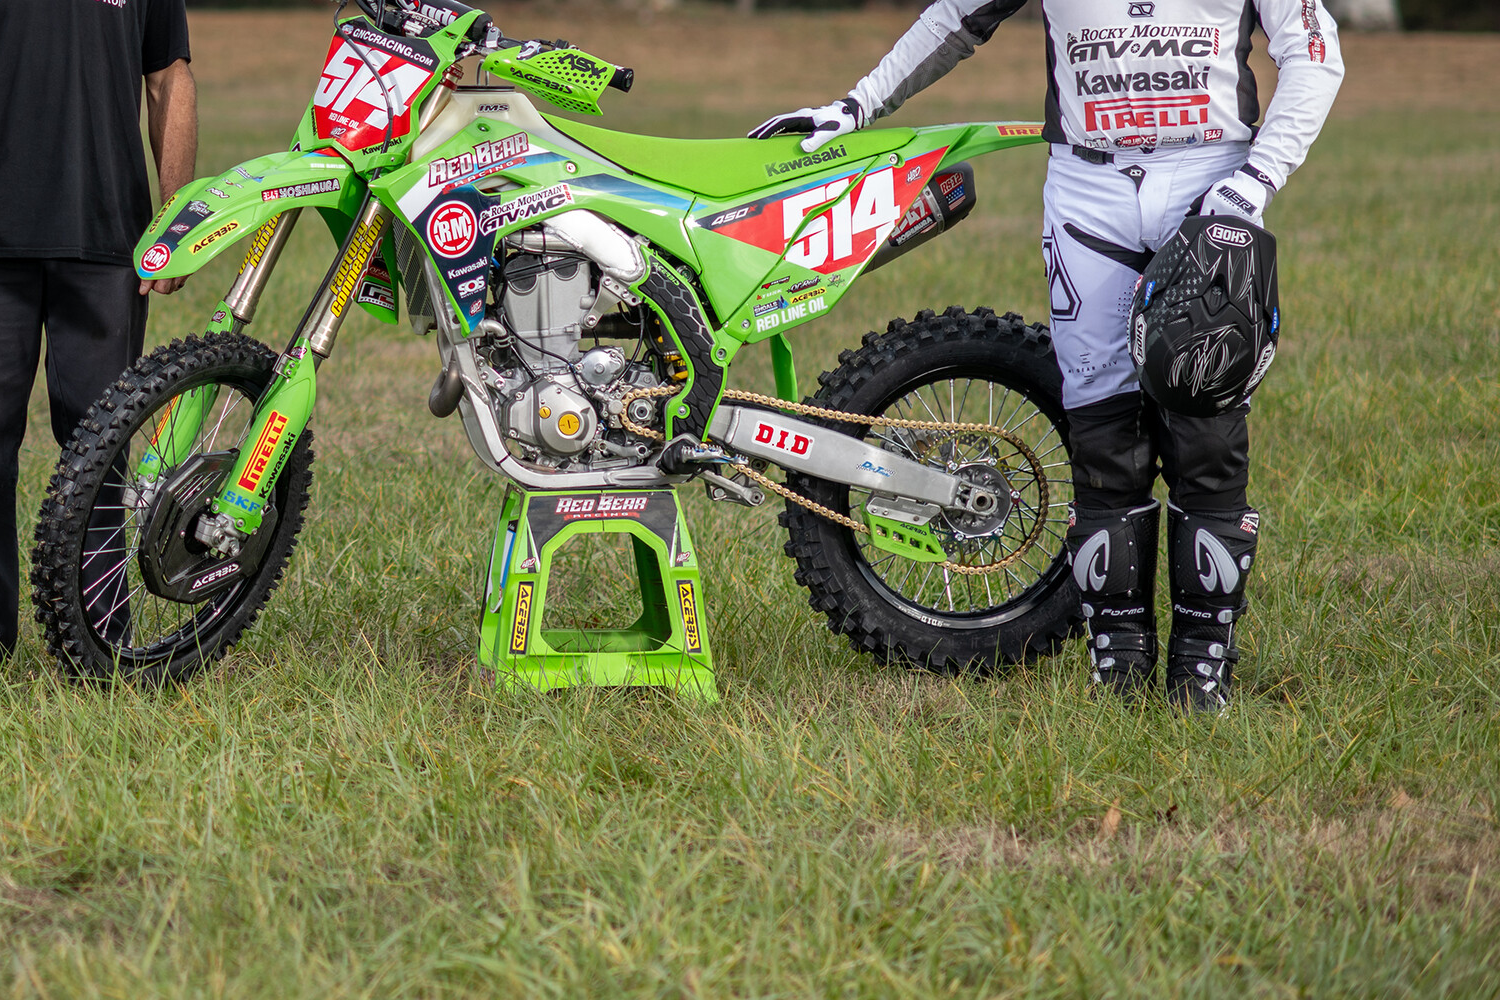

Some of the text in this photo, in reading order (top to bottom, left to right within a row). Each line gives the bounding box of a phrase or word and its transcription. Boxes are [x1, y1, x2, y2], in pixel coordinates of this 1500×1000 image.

[352, 27, 434, 67] GNCCRACING.COM
[1080, 24, 1215, 41] ROCKY MOUNTAIN
[559, 53, 607, 77] ASV
[313, 40, 432, 131] 514
[515, 70, 573, 94] ACERBIS
[1075, 65, 1211, 97] Kawasaki
[479, 103, 510, 113] IMS
[1084, 94, 1211, 132] PIRELLI
[362, 137, 403, 155] Kawaki
[428, 131, 529, 188] RED BEAR
[453, 160, 516, 187] RACING
[765, 145, 848, 177] Kawasaki
[279, 178, 340, 197] YOSHIMURA
[491, 185, 563, 215] ROCKY MOUNTAIN
[1222, 187, 1252, 210] MSR
[782, 167, 900, 271] 514
[895, 217, 934, 246] YOSHIMURA
[192, 222, 239, 254] ACERBIS
[1212, 226, 1248, 245] SHOEI
[447, 256, 488, 280] Kawasaki
[458, 275, 486, 296] SOS
[792, 288, 826, 304] ACERBIS
[756, 296, 828, 333] RED LINE OIL
[1135, 321, 1145, 359] SHOEI
[238, 411, 288, 492] PIRELLI
[755, 423, 811, 456] D.I.D
[259, 432, 297, 499] Kawasaki
[223, 491, 262, 513] SKF
[555, 495, 650, 514] RED BEAR
[900, 523, 928, 536] ACERBIS
[192, 563, 240, 589] ACERBIS
[515, 587, 530, 649] ACERBIS
[681, 586, 699, 647] ACERBIS
